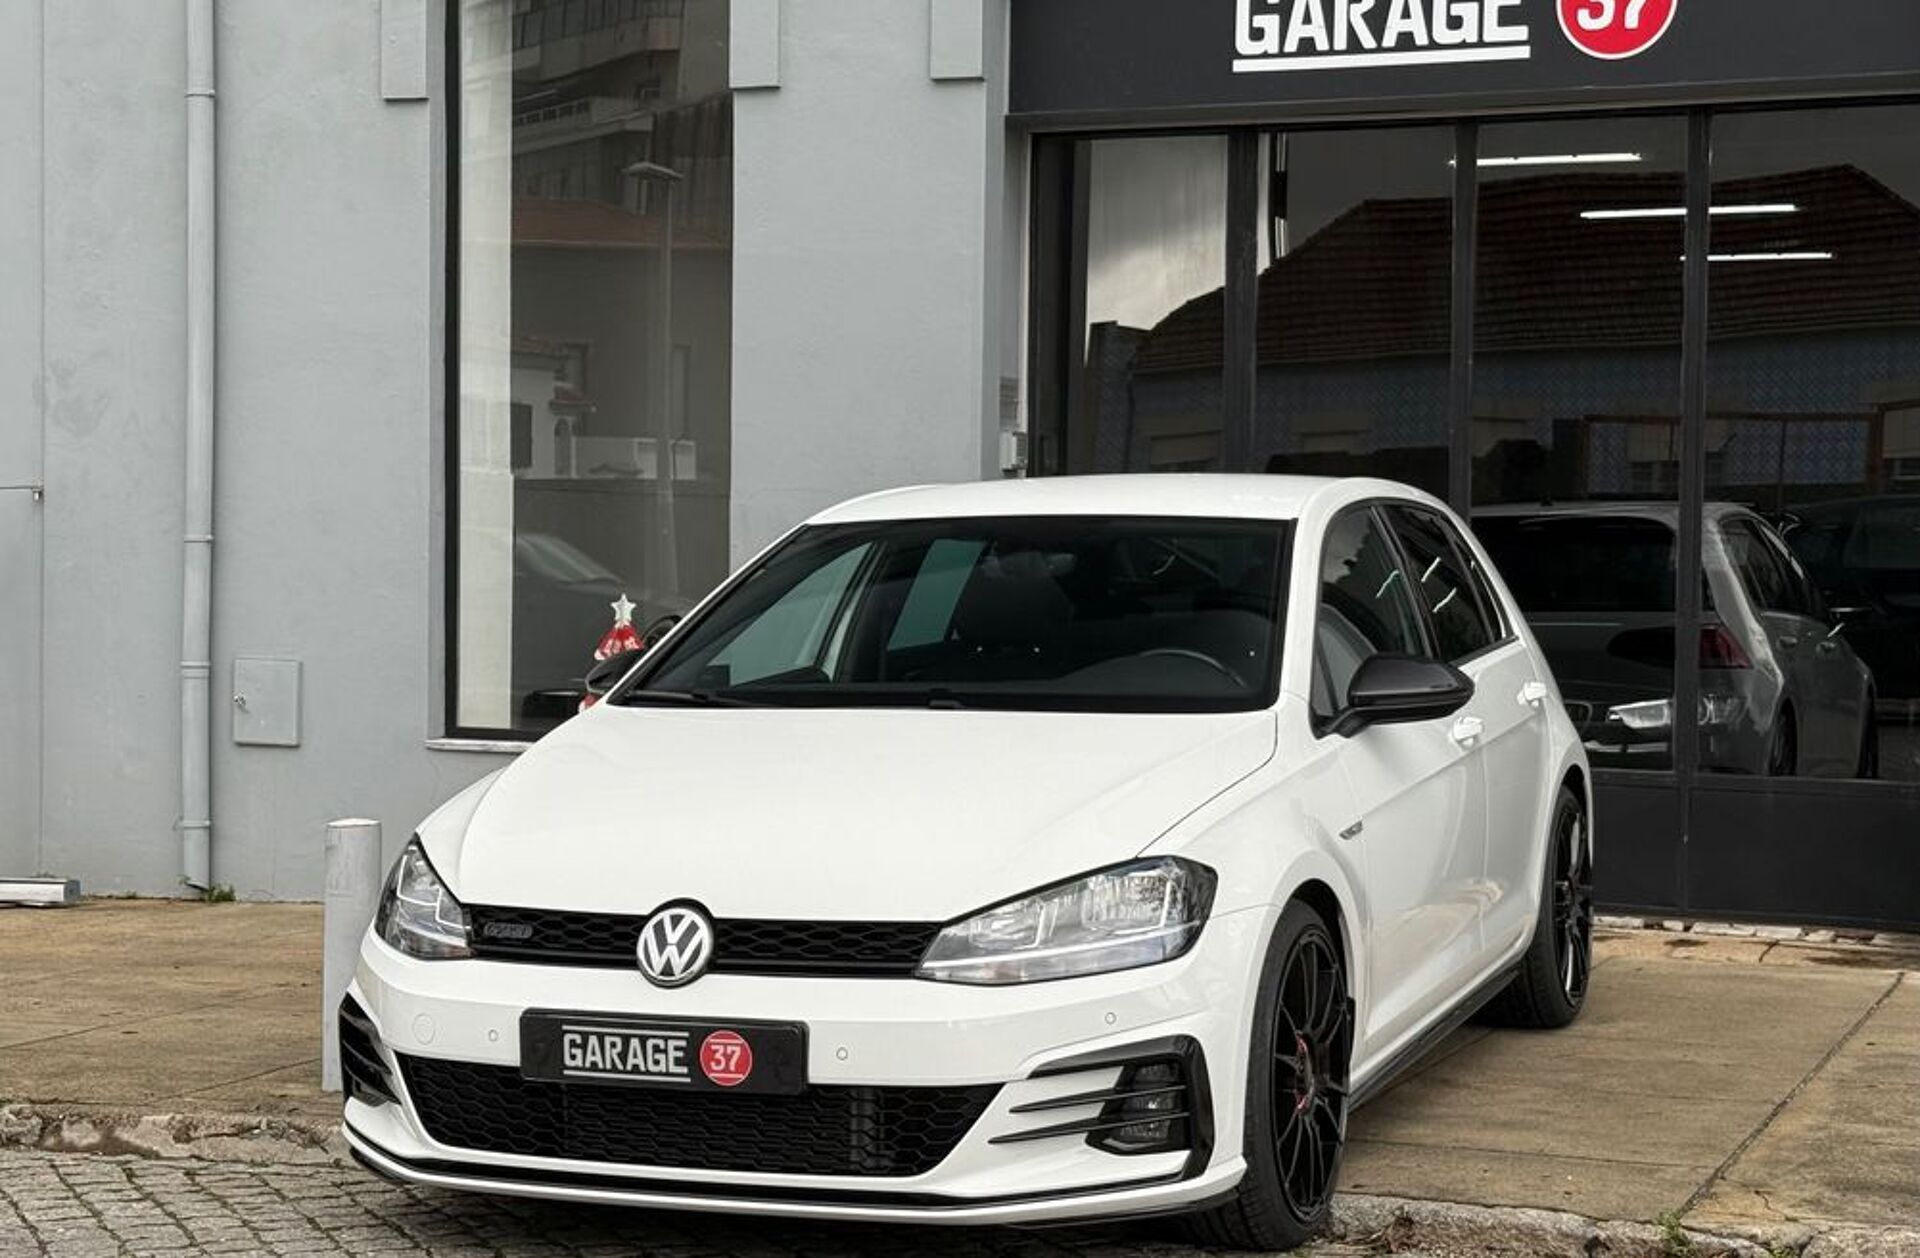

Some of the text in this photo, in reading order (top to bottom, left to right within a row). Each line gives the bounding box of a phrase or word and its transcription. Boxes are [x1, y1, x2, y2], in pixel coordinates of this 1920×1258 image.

[1234, 0, 1529, 55] GARAGE
[563, 1033, 742, 1075] GARAGE 37
